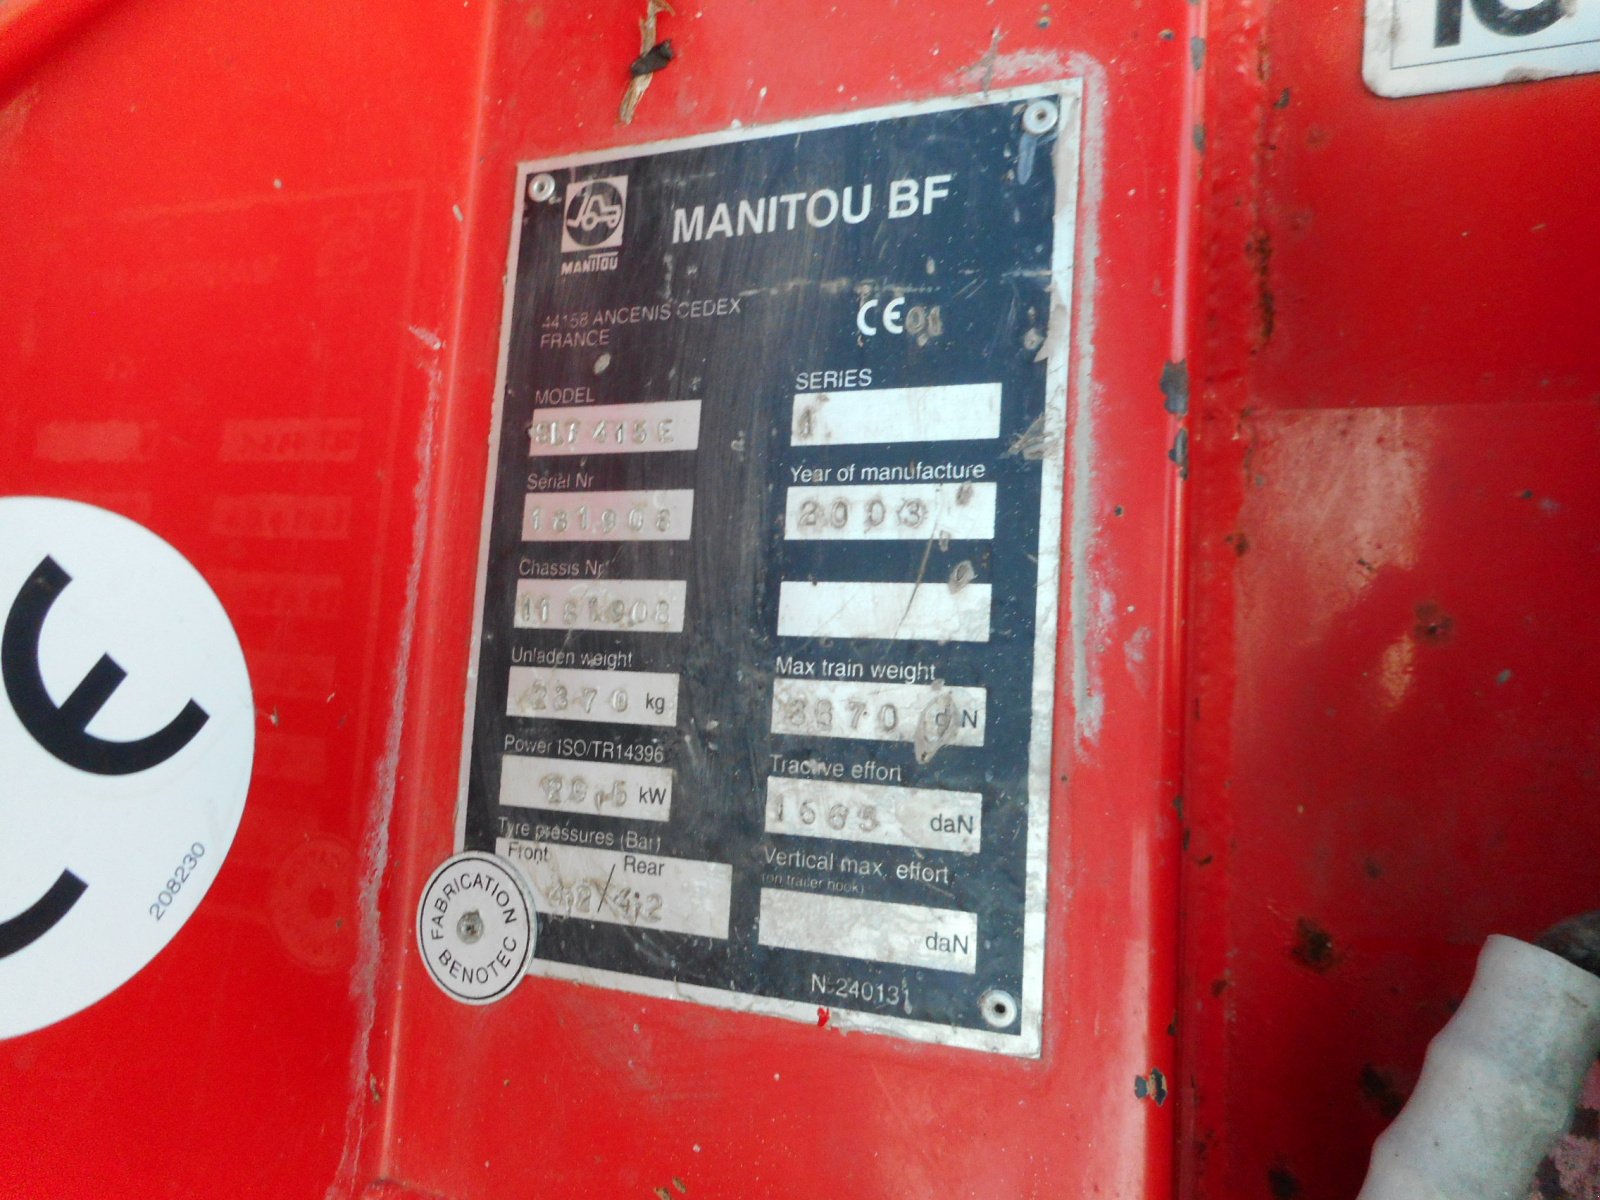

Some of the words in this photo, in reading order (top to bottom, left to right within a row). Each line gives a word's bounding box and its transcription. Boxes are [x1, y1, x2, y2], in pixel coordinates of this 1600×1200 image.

[672, 184, 872, 245] MANITOU
[887, 174, 952, 221] BF
[561, 252, 619, 275] MANITOU
[592, 303, 672, 327] ANCENIS
[676, 297, 742, 319] CEDEX
[540, 329, 611, 349] FRANCE
[795, 368, 873, 391] SERIES
[535, 386, 596, 405] MODEL
[527, 472, 571, 491] Serial
[575, 472, 595, 489] Nr
[790, 464, 832, 484] Year
[836, 463, 857, 482] of
[861, 461, 986, 482] manufacture
[799, 496, 928, 530] 2003
[519, 558, 580, 577] Chassis
[511, 646, 575, 665] Unladen
[580, 649, 633, 671] weight
[775, 655, 817, 677] Max
[822, 658, 864, 678] train
[870, 661, 936, 683] weight
[645, 692, 666, 715] kg
[503, 734, 553, 754] Power
[557, 738, 665, 764] ISO/TR14396
[769, 753, 845, 778] Tracive
[851, 760, 902, 782] effort
[638, 786, 667, 806] kW
[498, 815, 530, 839] Tyre
[534, 824, 615, 847] pressures
[930, 814, 974, 835] daN
[508, 840, 549, 862] Front
[623, 854, 665, 877] Rear
[763, 845, 834, 871] Vertical
[896, 861, 950, 884] effort
[149, 840, 206, 921] 208230
[431, 872, 518, 941] FABRICATION
[925, 932, 969, 955] daN
[438, 935, 517, 985] BENOTEC
[835, 977, 910, 1007] 240131
